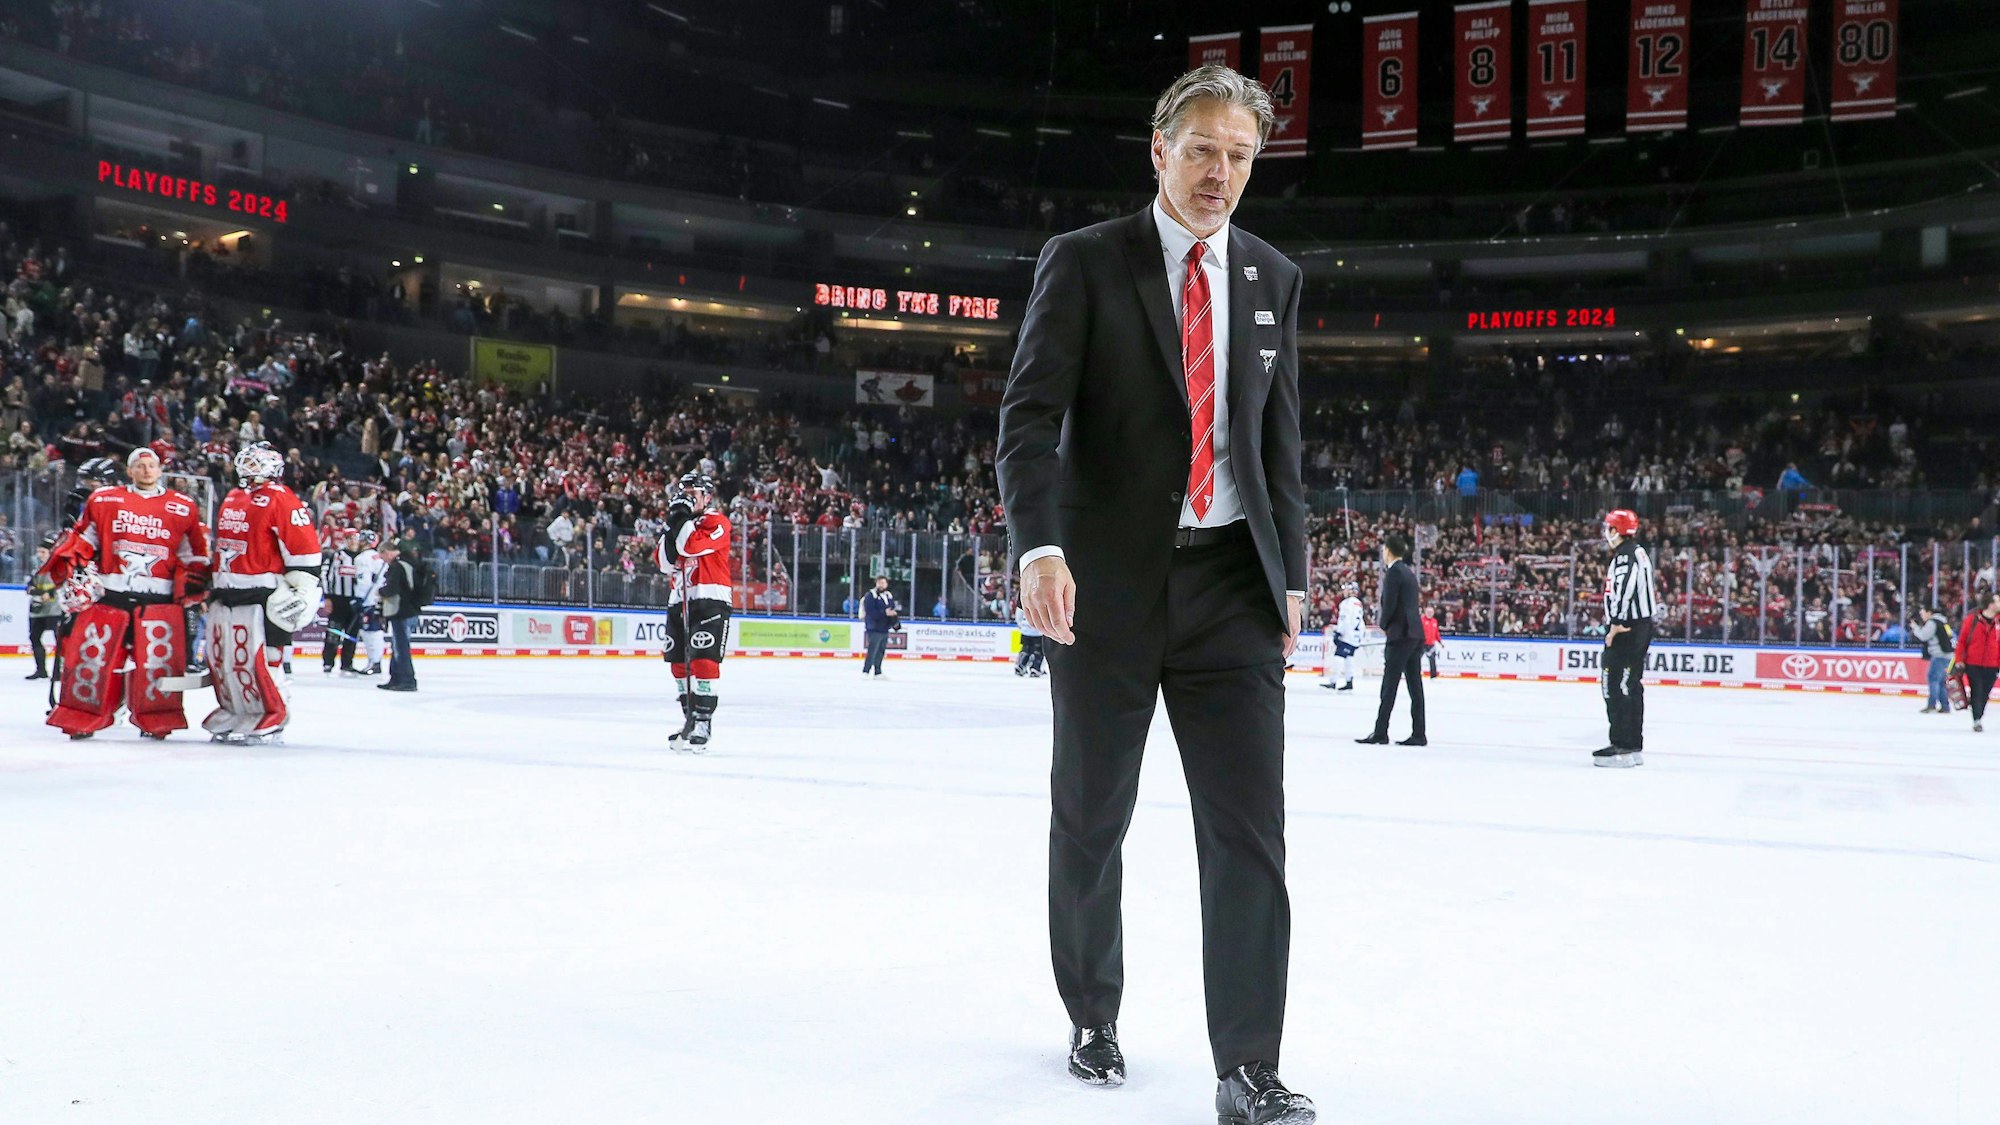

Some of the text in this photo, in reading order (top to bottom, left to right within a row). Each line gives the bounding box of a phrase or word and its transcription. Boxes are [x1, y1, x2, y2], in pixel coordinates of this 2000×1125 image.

[1464, 27, 1500, 41] PHILIPP
[1471, 17, 1493, 29] RALF
[1751, 26, 1799, 71] 14
[1837, 18, 1893, 67] 80
[1468, 45, 1496, 88] 8
[1537, 39, 1577, 84] 11
[1636, 33, 1683, 79] 12
[1272, 67, 1296, 108] 4
[1378, 57, 1403, 98] 6
[98, 160, 287, 224] PLAYOFFS 2024
[815, 283, 1000, 320] BRING THE FIRE
[1468, 307, 1615, 329] PLAYOFFS 2024
[112, 520, 171, 539] Energie
[117, 509, 163, 528] Rhein
[290, 508, 310, 527] 45
[412, 614, 497, 640] MSPORTS
[569, 620, 590, 632] Time
[1296, 642, 1323, 652] Karri
[1822, 658, 1909, 684] TOYOTA
